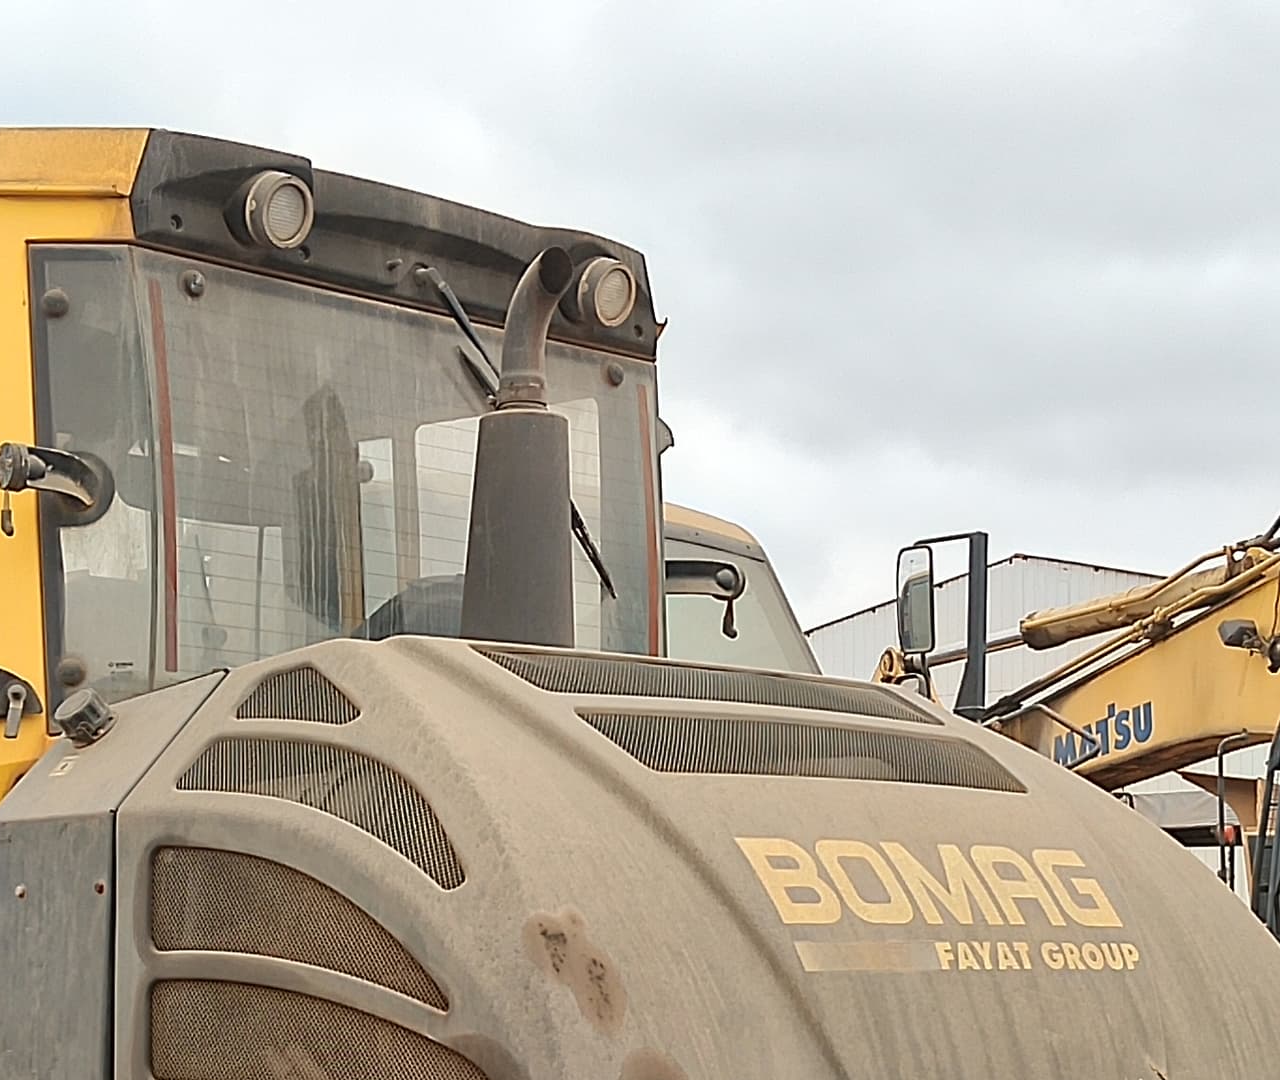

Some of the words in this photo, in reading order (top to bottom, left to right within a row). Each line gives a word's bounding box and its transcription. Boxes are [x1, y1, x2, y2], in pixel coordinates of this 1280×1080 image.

[734, 837, 1123, 928] BOMAG
[936, 941, 1032, 971] FAYAT
[1041, 942, 1140, 971] GROUP
